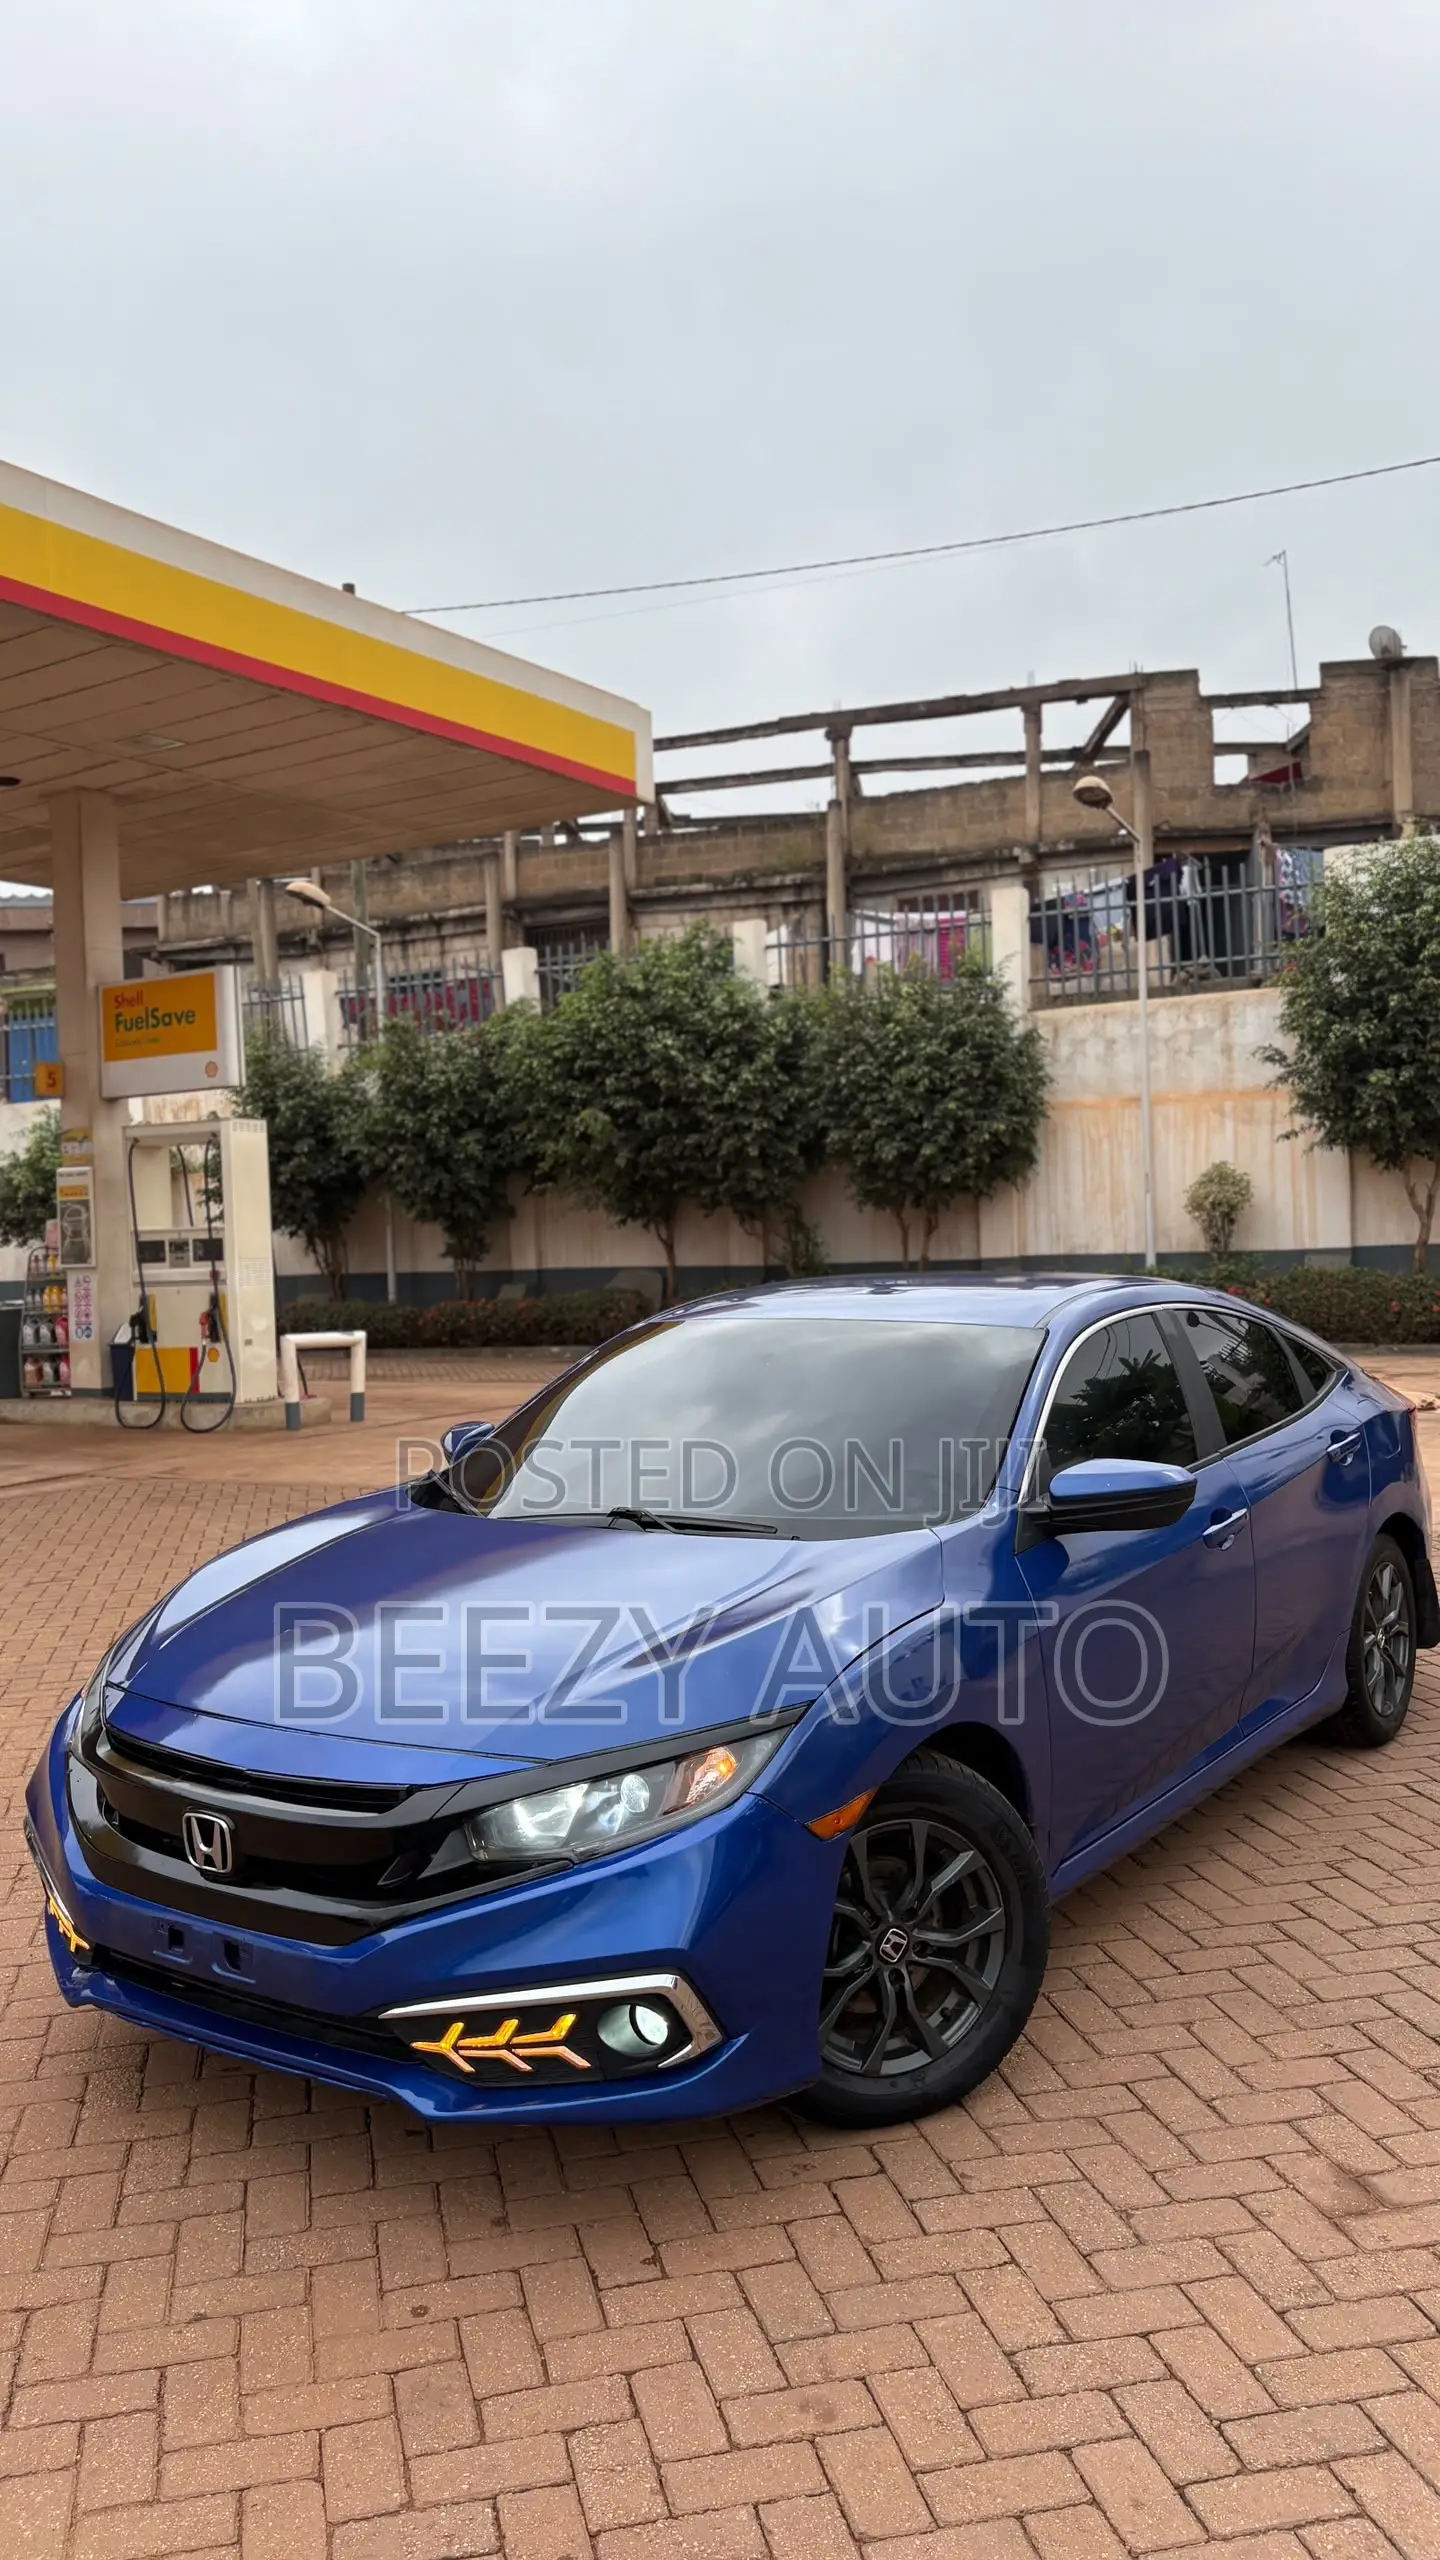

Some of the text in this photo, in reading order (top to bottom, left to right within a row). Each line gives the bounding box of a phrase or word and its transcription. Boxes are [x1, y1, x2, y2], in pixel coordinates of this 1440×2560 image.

[114, 989, 144, 1010] Shell
[115, 1007, 196, 1033] FuelSave
[46, 1070, 57, 1088] 5
